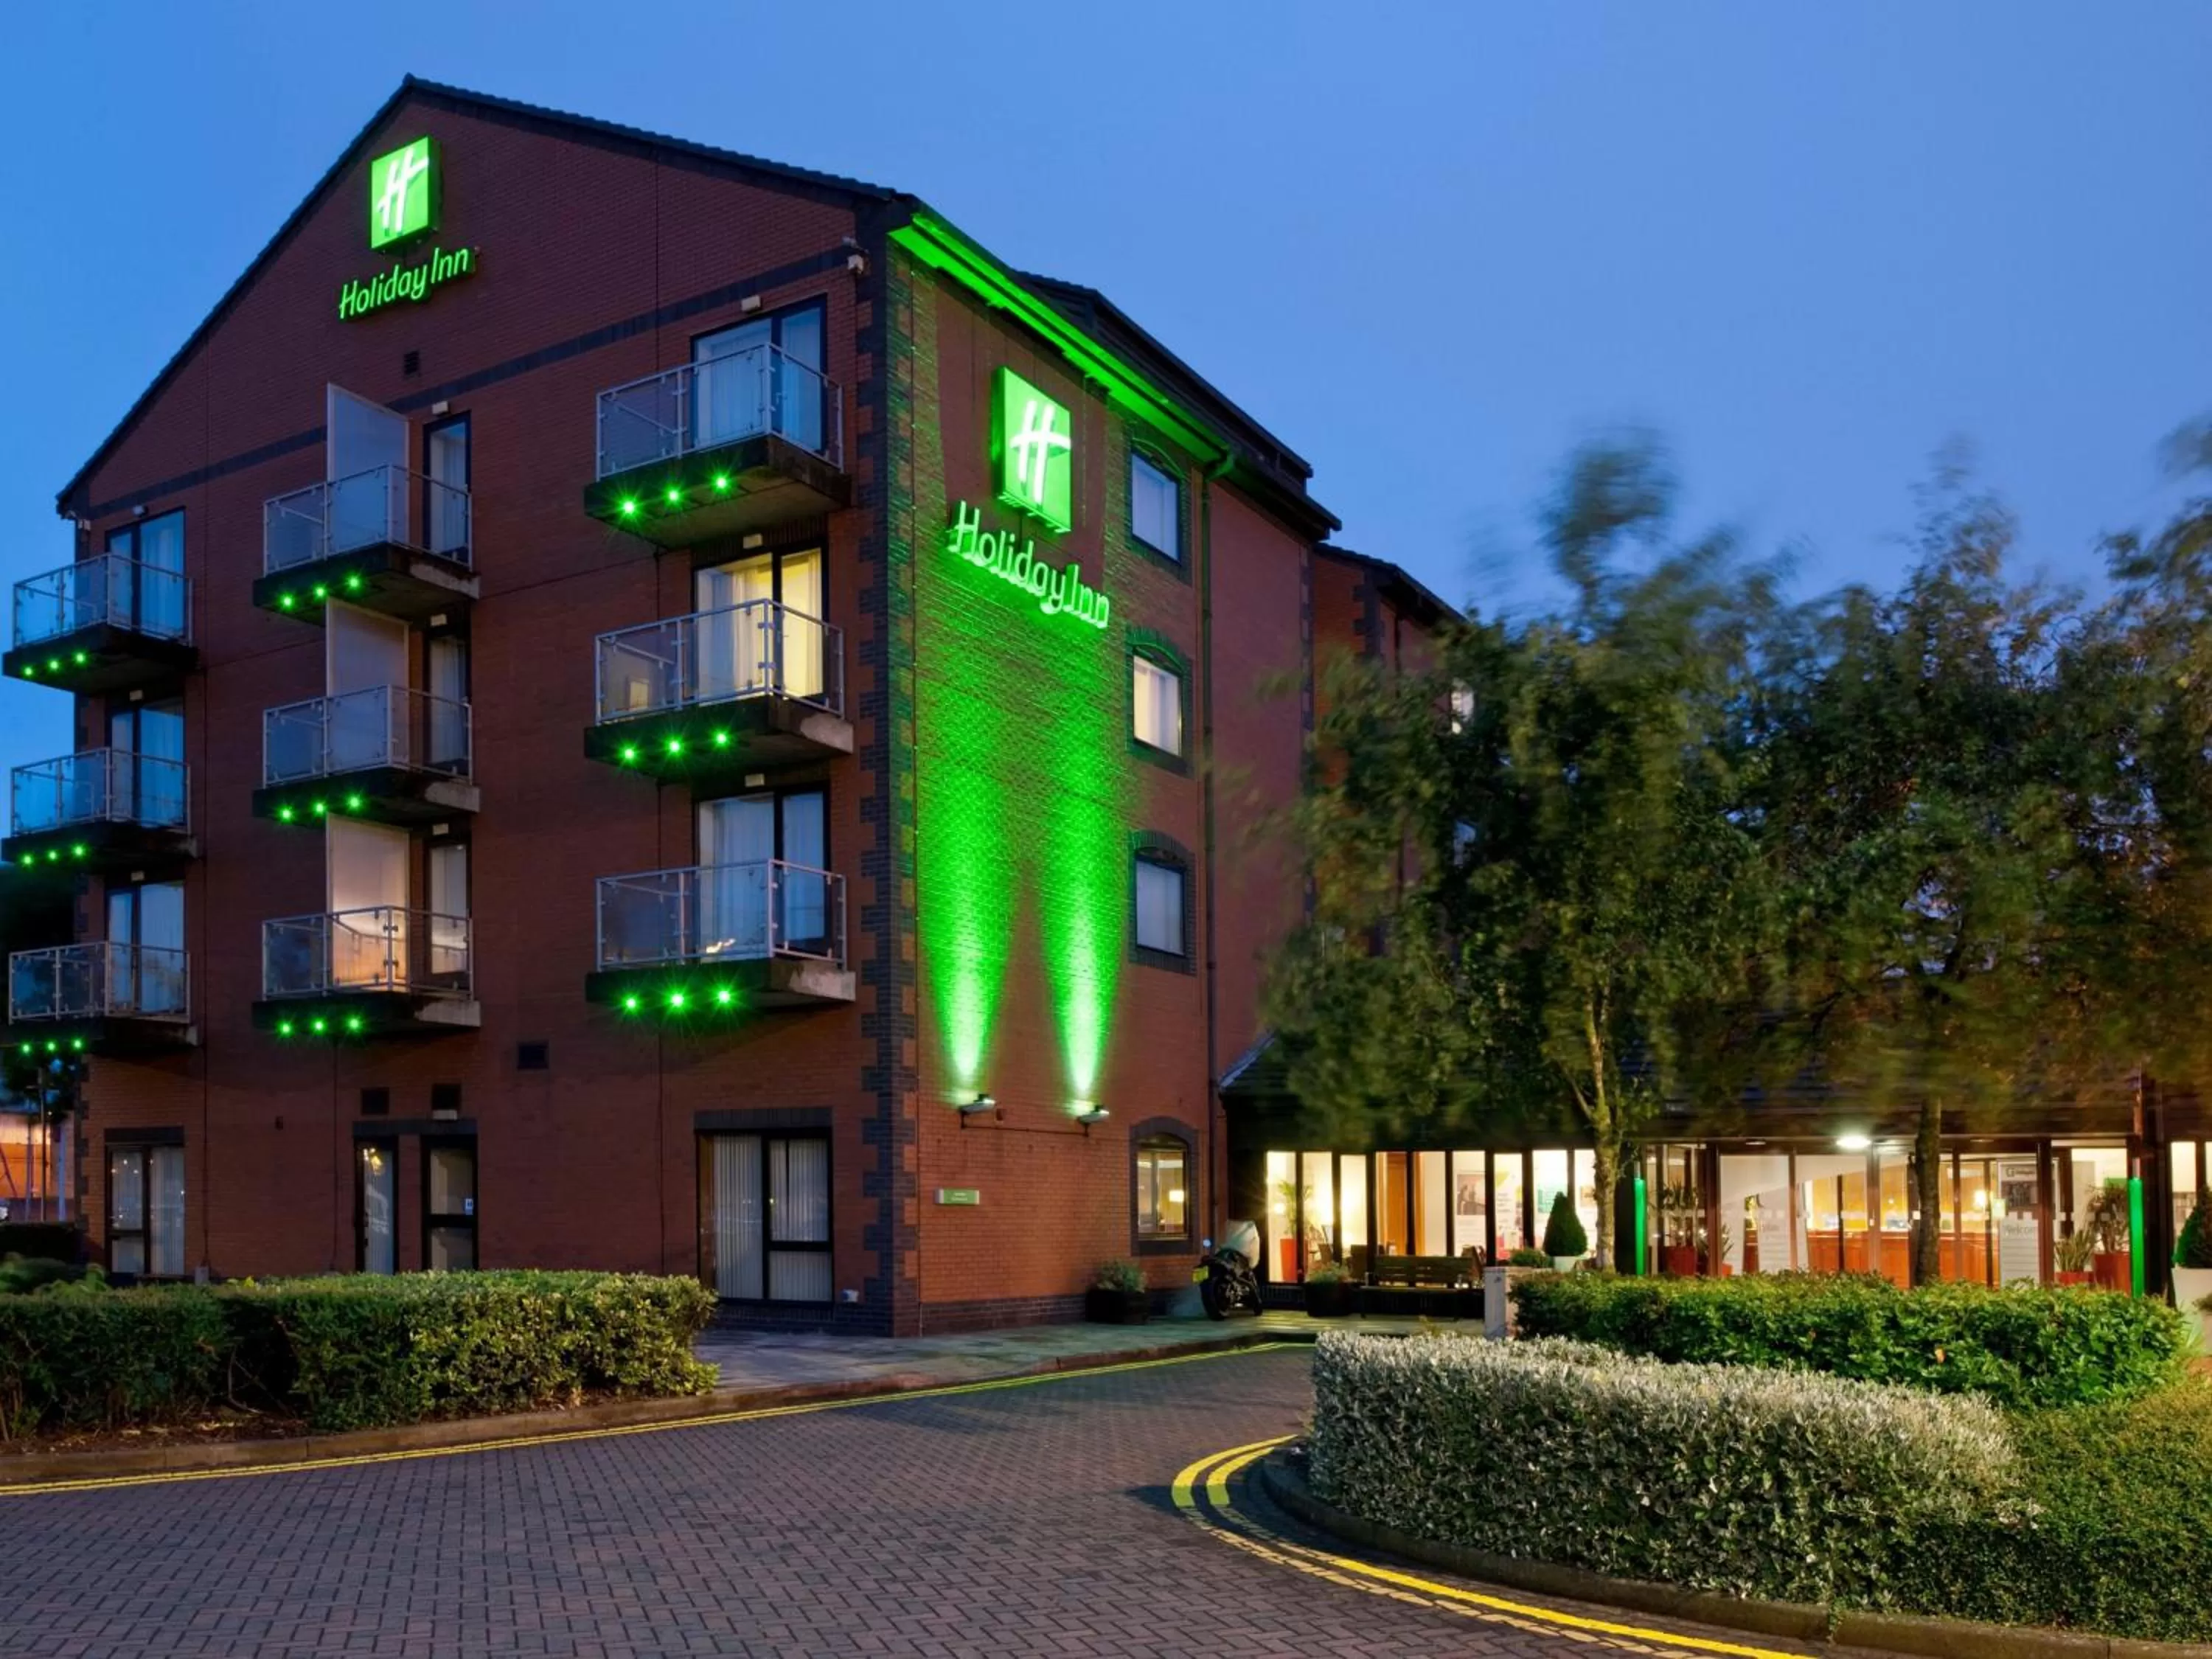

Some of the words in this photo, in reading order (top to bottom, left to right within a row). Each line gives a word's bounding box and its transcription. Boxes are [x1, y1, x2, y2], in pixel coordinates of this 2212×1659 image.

[339, 263, 428, 319] Holiday
[431, 247, 469, 285] Inn
[949, 500, 1065, 614] Holiday
[1066, 563, 1110, 629] Inn
